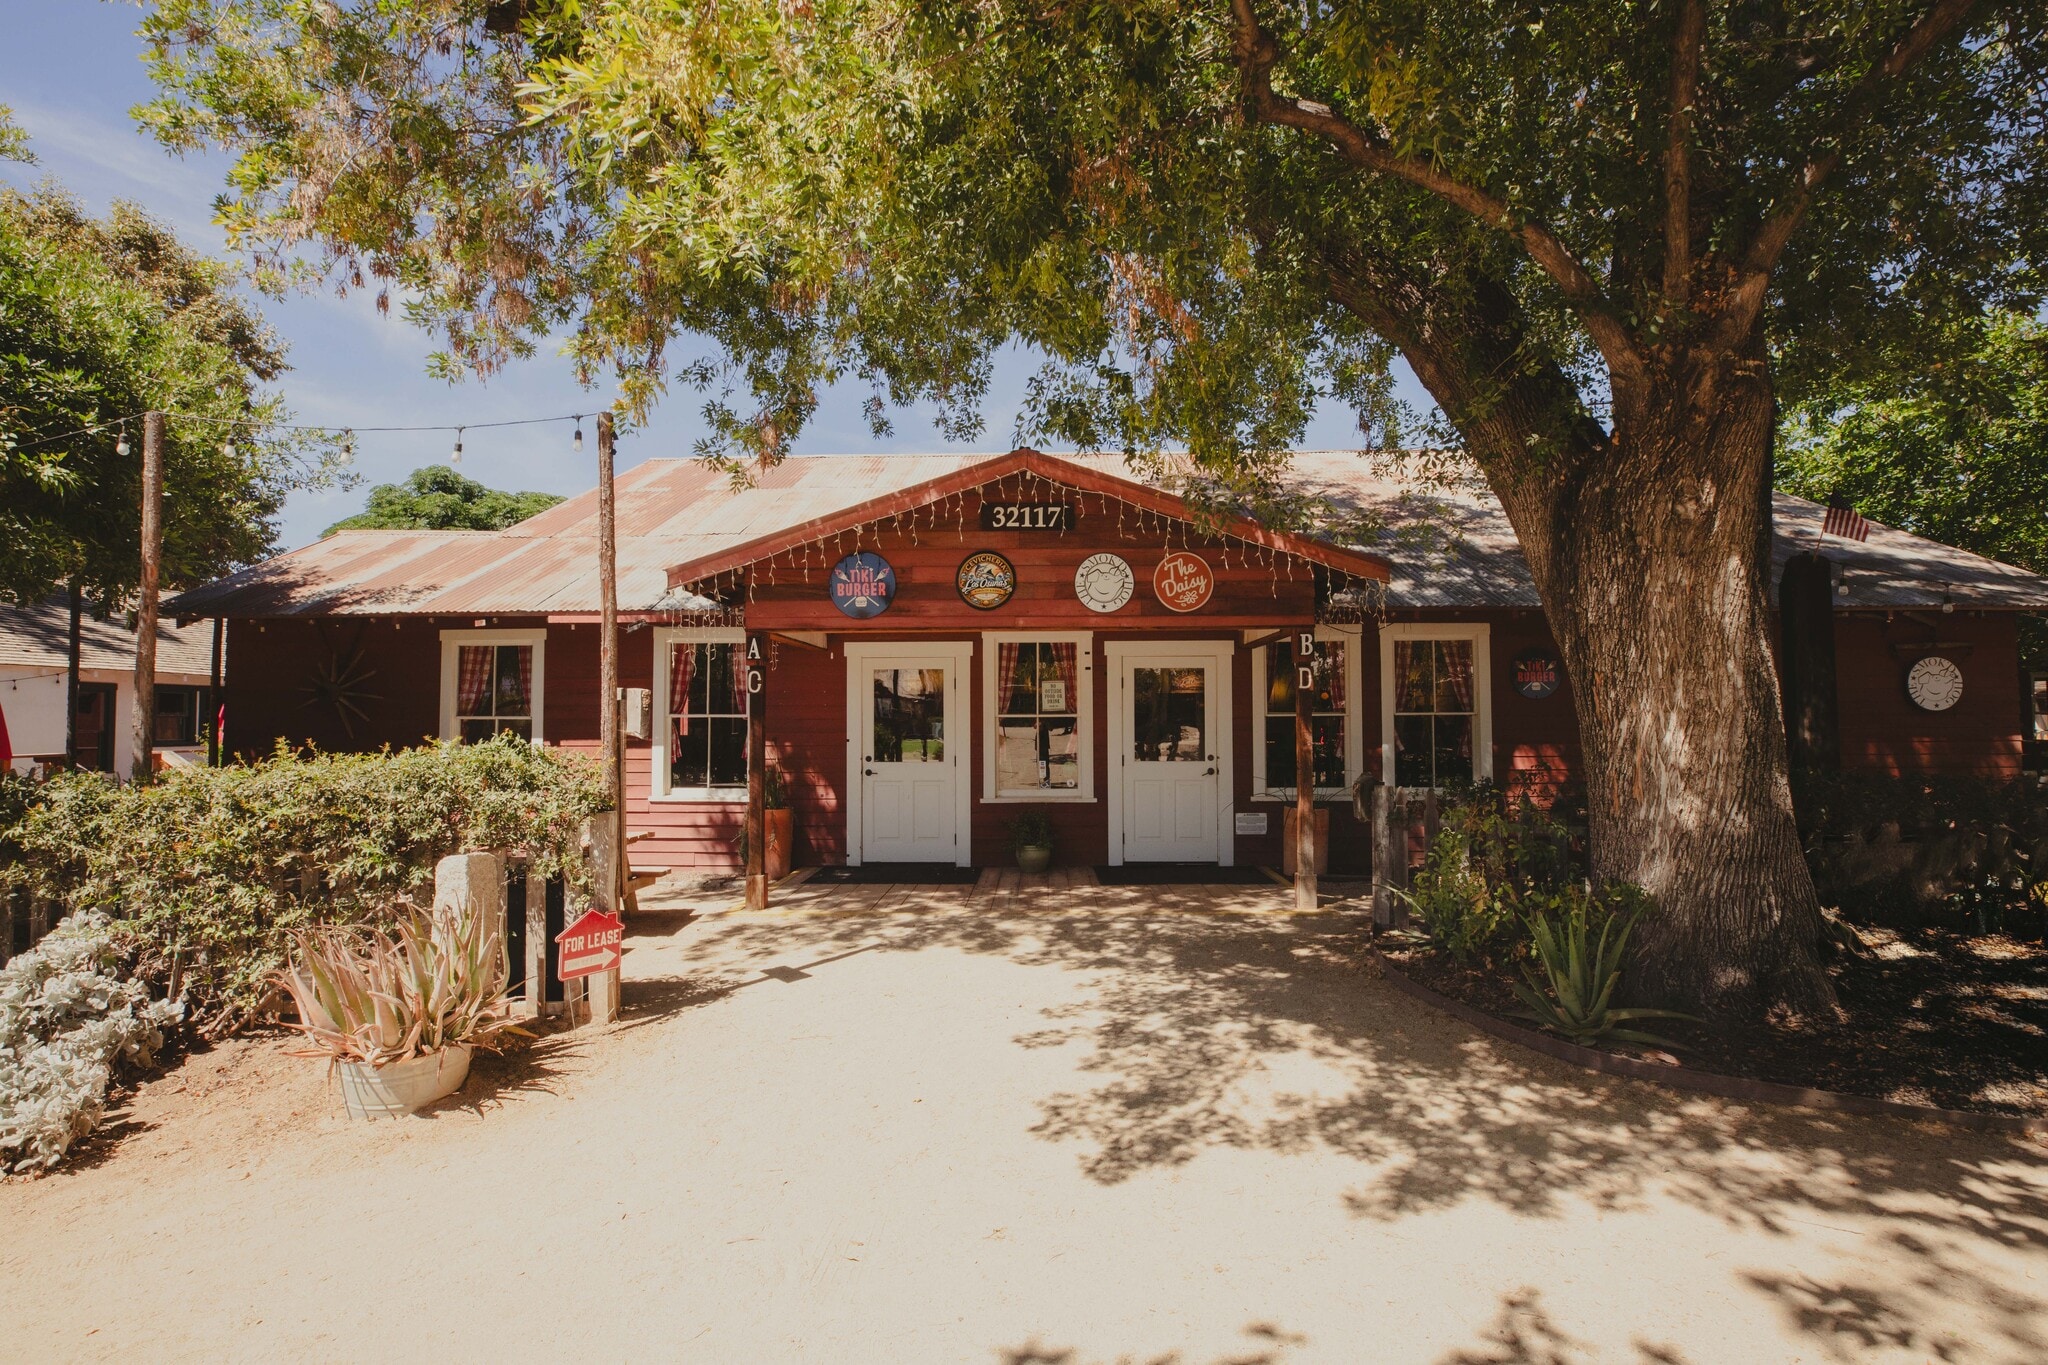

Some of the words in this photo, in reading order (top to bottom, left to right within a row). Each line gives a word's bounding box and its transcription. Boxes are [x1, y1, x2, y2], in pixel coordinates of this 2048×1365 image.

[992, 506, 1061, 528] 32117
[965, 555, 1008, 572] CEVICHERIA
[1164, 558, 1197, 581] The
[836, 582, 887, 597] BURGER
[962, 579, 980, 594] Los
[1113, 581, 1133, 607] HOG
[1161, 575, 1208, 597] Daisy
[747, 637, 761, 660] A
[1299, 633, 1314, 656] B
[748, 670, 762, 693] C
[1298, 667, 1312, 689] D
[1517, 671, 1556, 682] BURGER
[564, 935, 585, 954] FOR
[587, 929, 620, 949] LEASE
